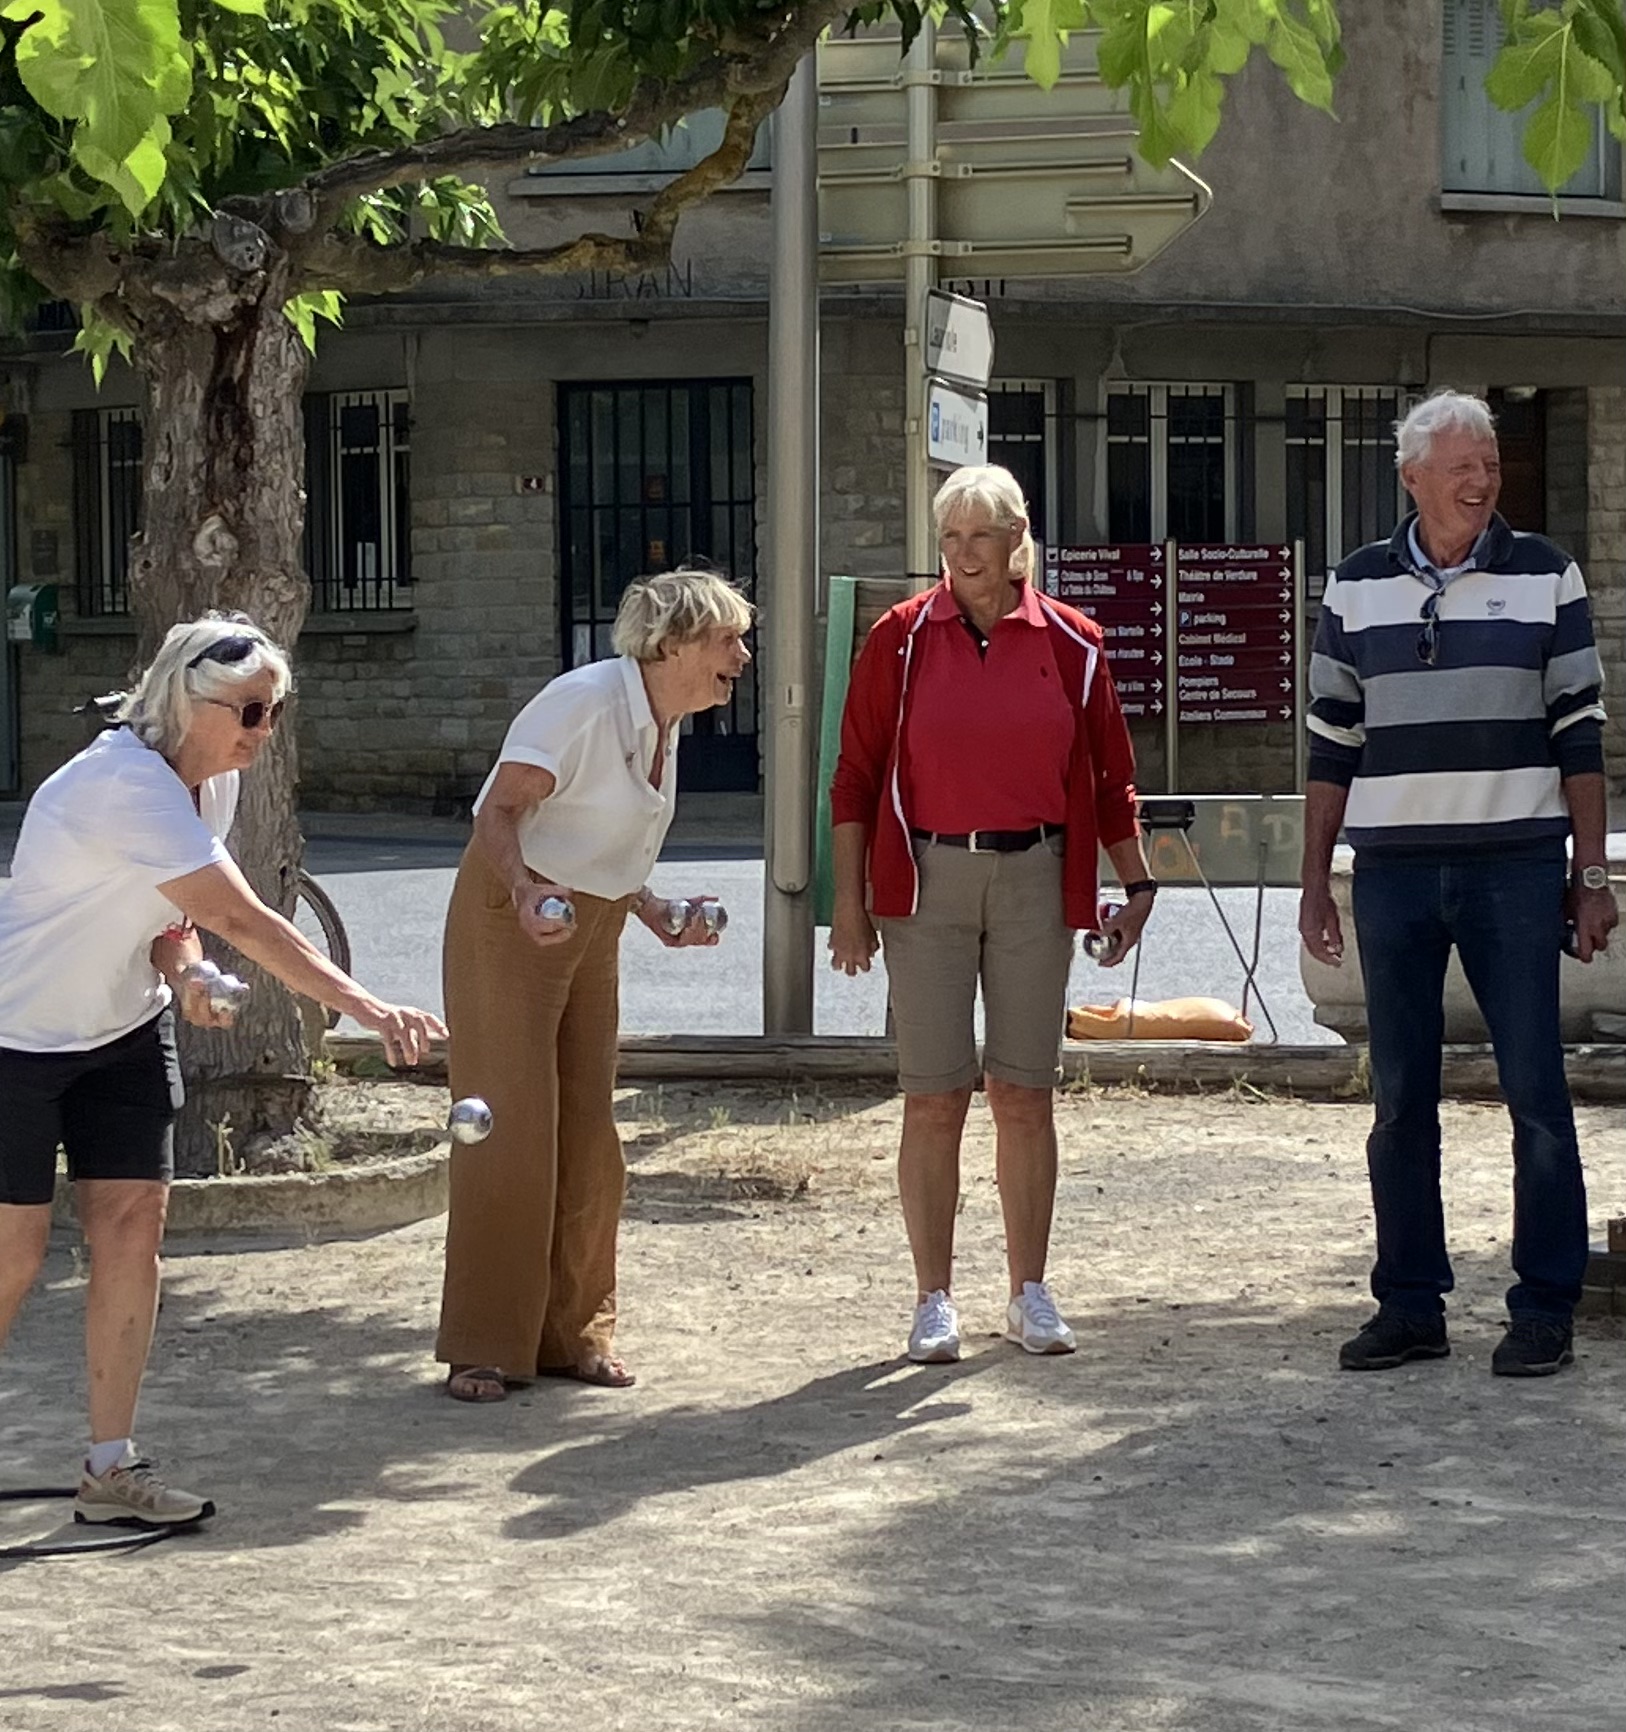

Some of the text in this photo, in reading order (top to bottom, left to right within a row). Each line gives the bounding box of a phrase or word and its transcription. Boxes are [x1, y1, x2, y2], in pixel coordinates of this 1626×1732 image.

[1178, 548, 1199, 561] Salle
[1212, 570, 1223, 581] de
[1225, 570, 1258, 581] Verdure
[1178, 592, 1205, 603] Mairie
[1193, 612, 1227, 626] parking
[1178, 633, 1212, 645] Cabinet
[1210, 654, 1235, 666] Stade
[1178, 676, 1219, 688] Pompiers
[1178, 687, 1257, 701] Centre de Secours
[1179, 710, 1212, 722] Ateliers
